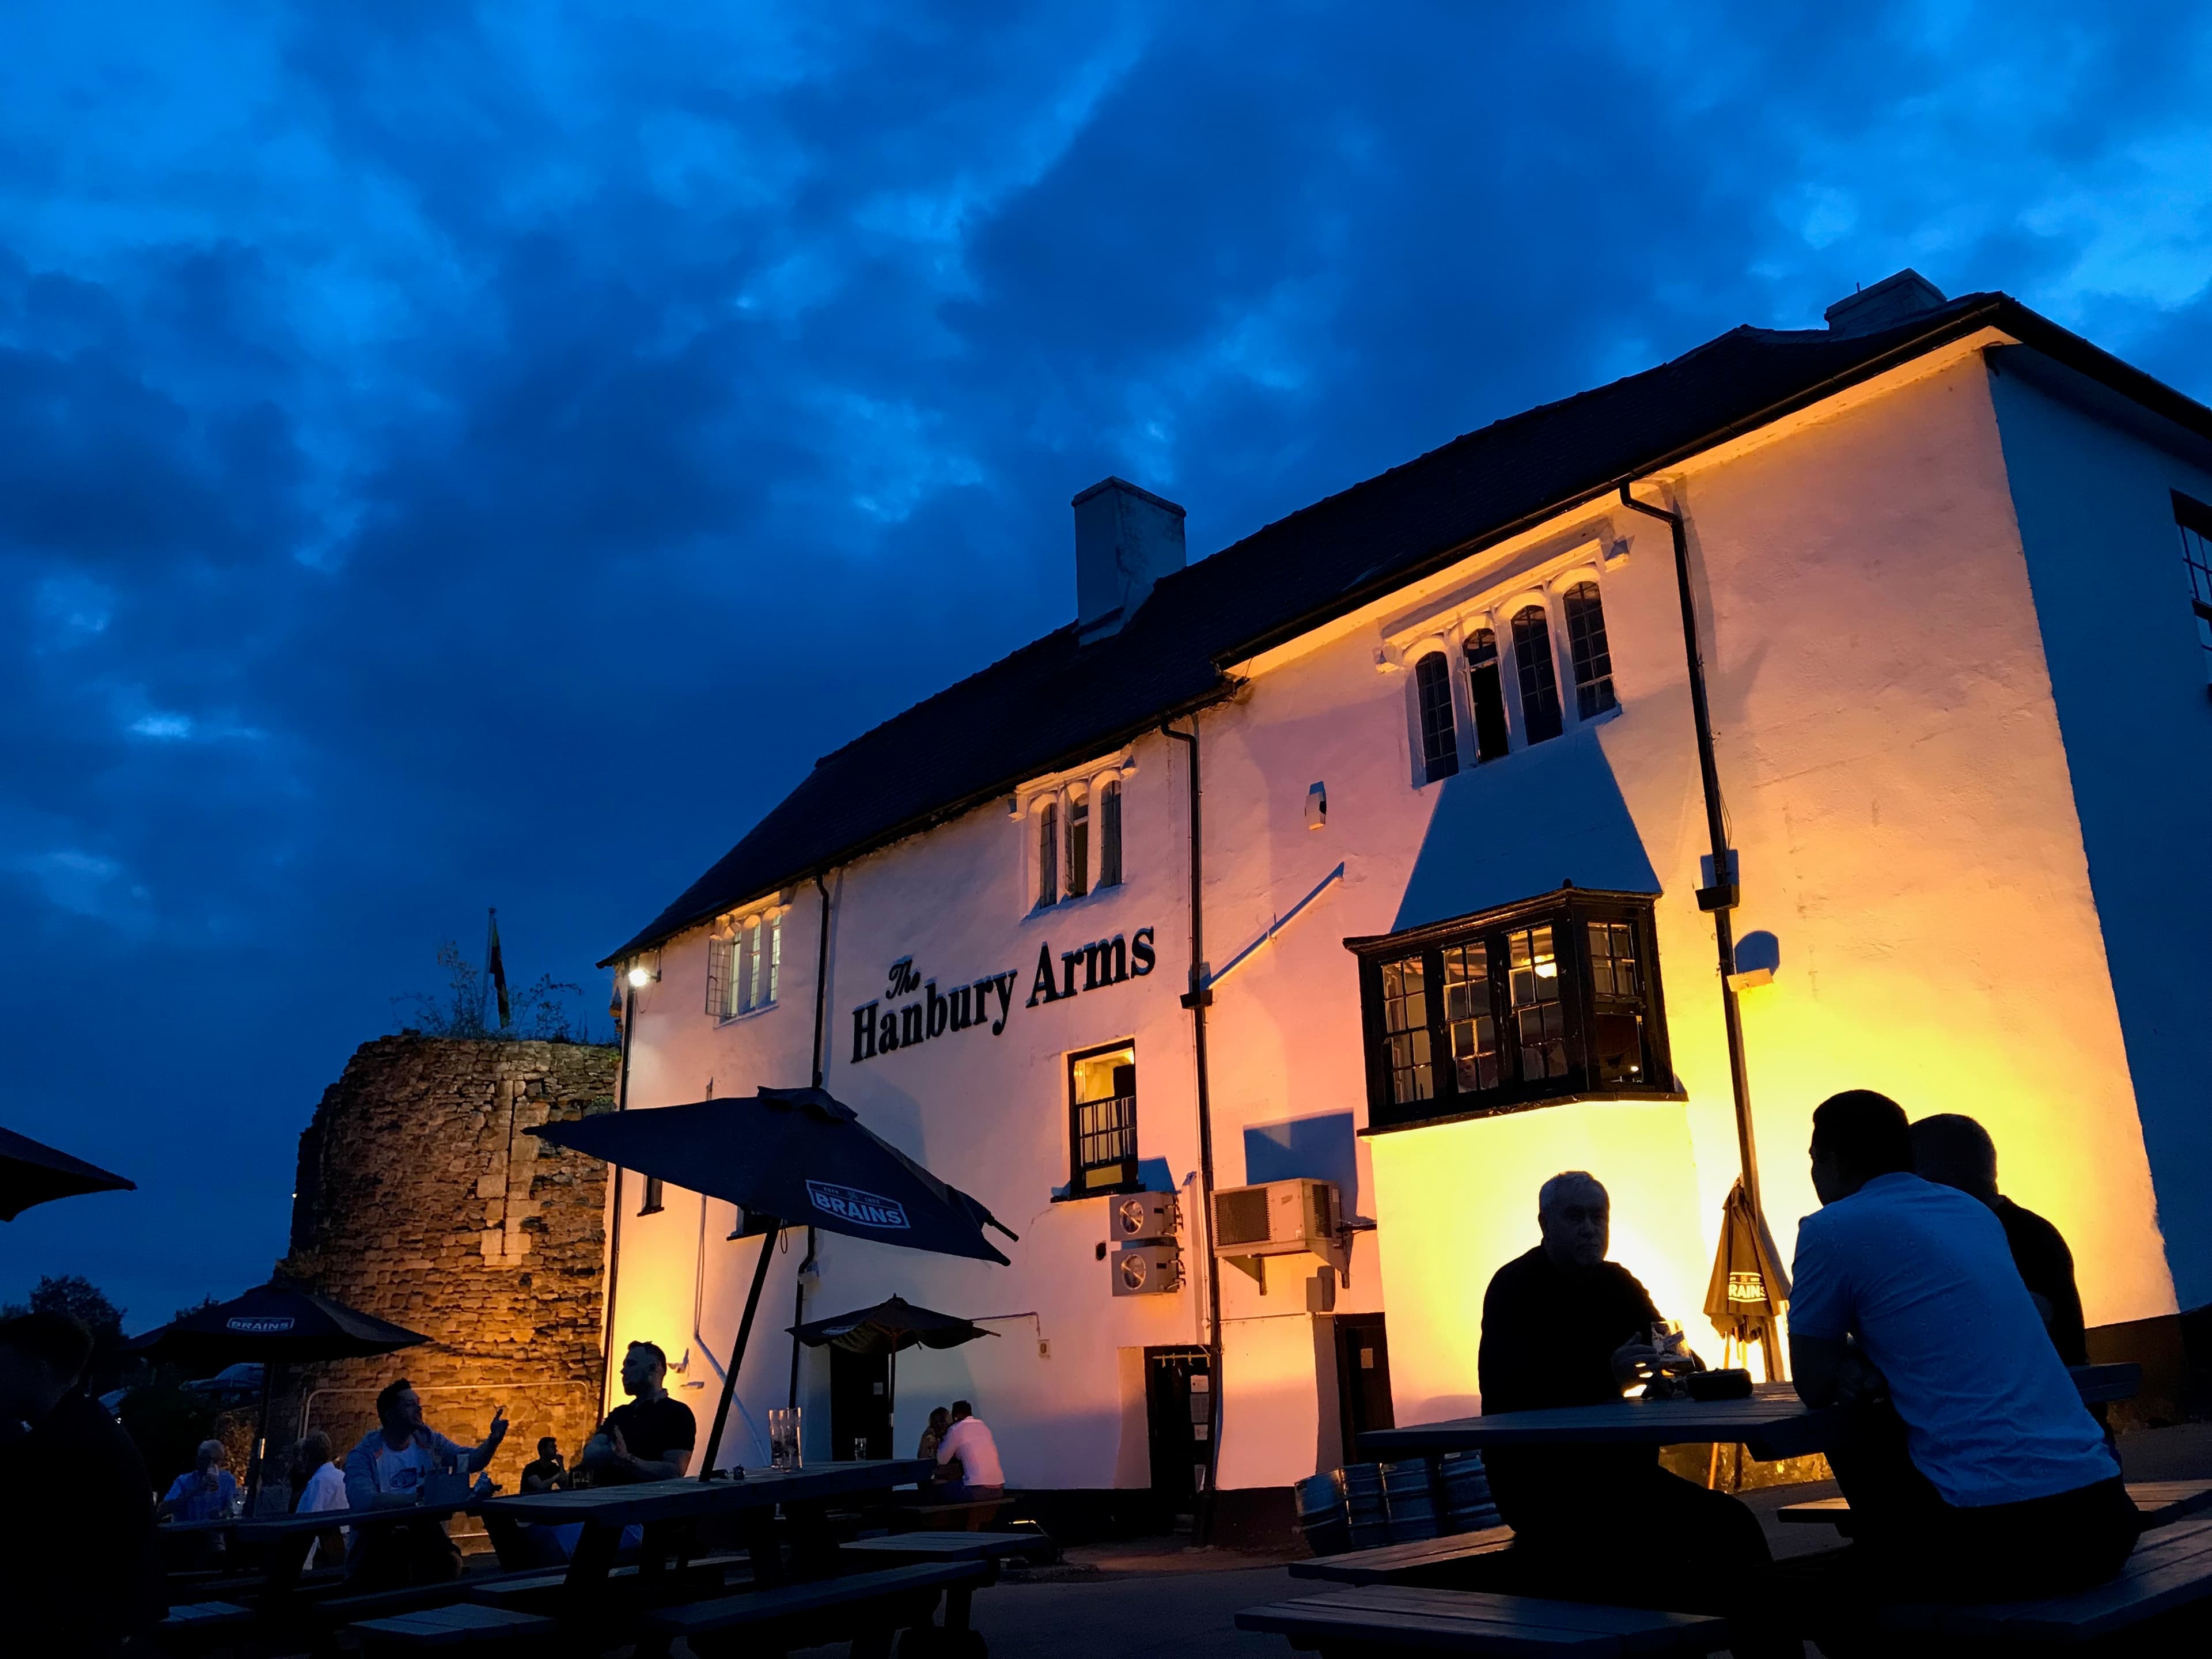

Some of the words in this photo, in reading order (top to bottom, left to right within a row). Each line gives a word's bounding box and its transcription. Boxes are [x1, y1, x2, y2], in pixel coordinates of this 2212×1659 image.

[885, 956, 921, 1000] The
[850, 969, 1018, 1064] Hanbury
[1025, 926, 1156, 1009] Arms
[815, 1192, 902, 1225] BRAINS
[1728, 1283, 1766, 1298] RAINS
[231, 1321, 289, 1330] BRAINS
